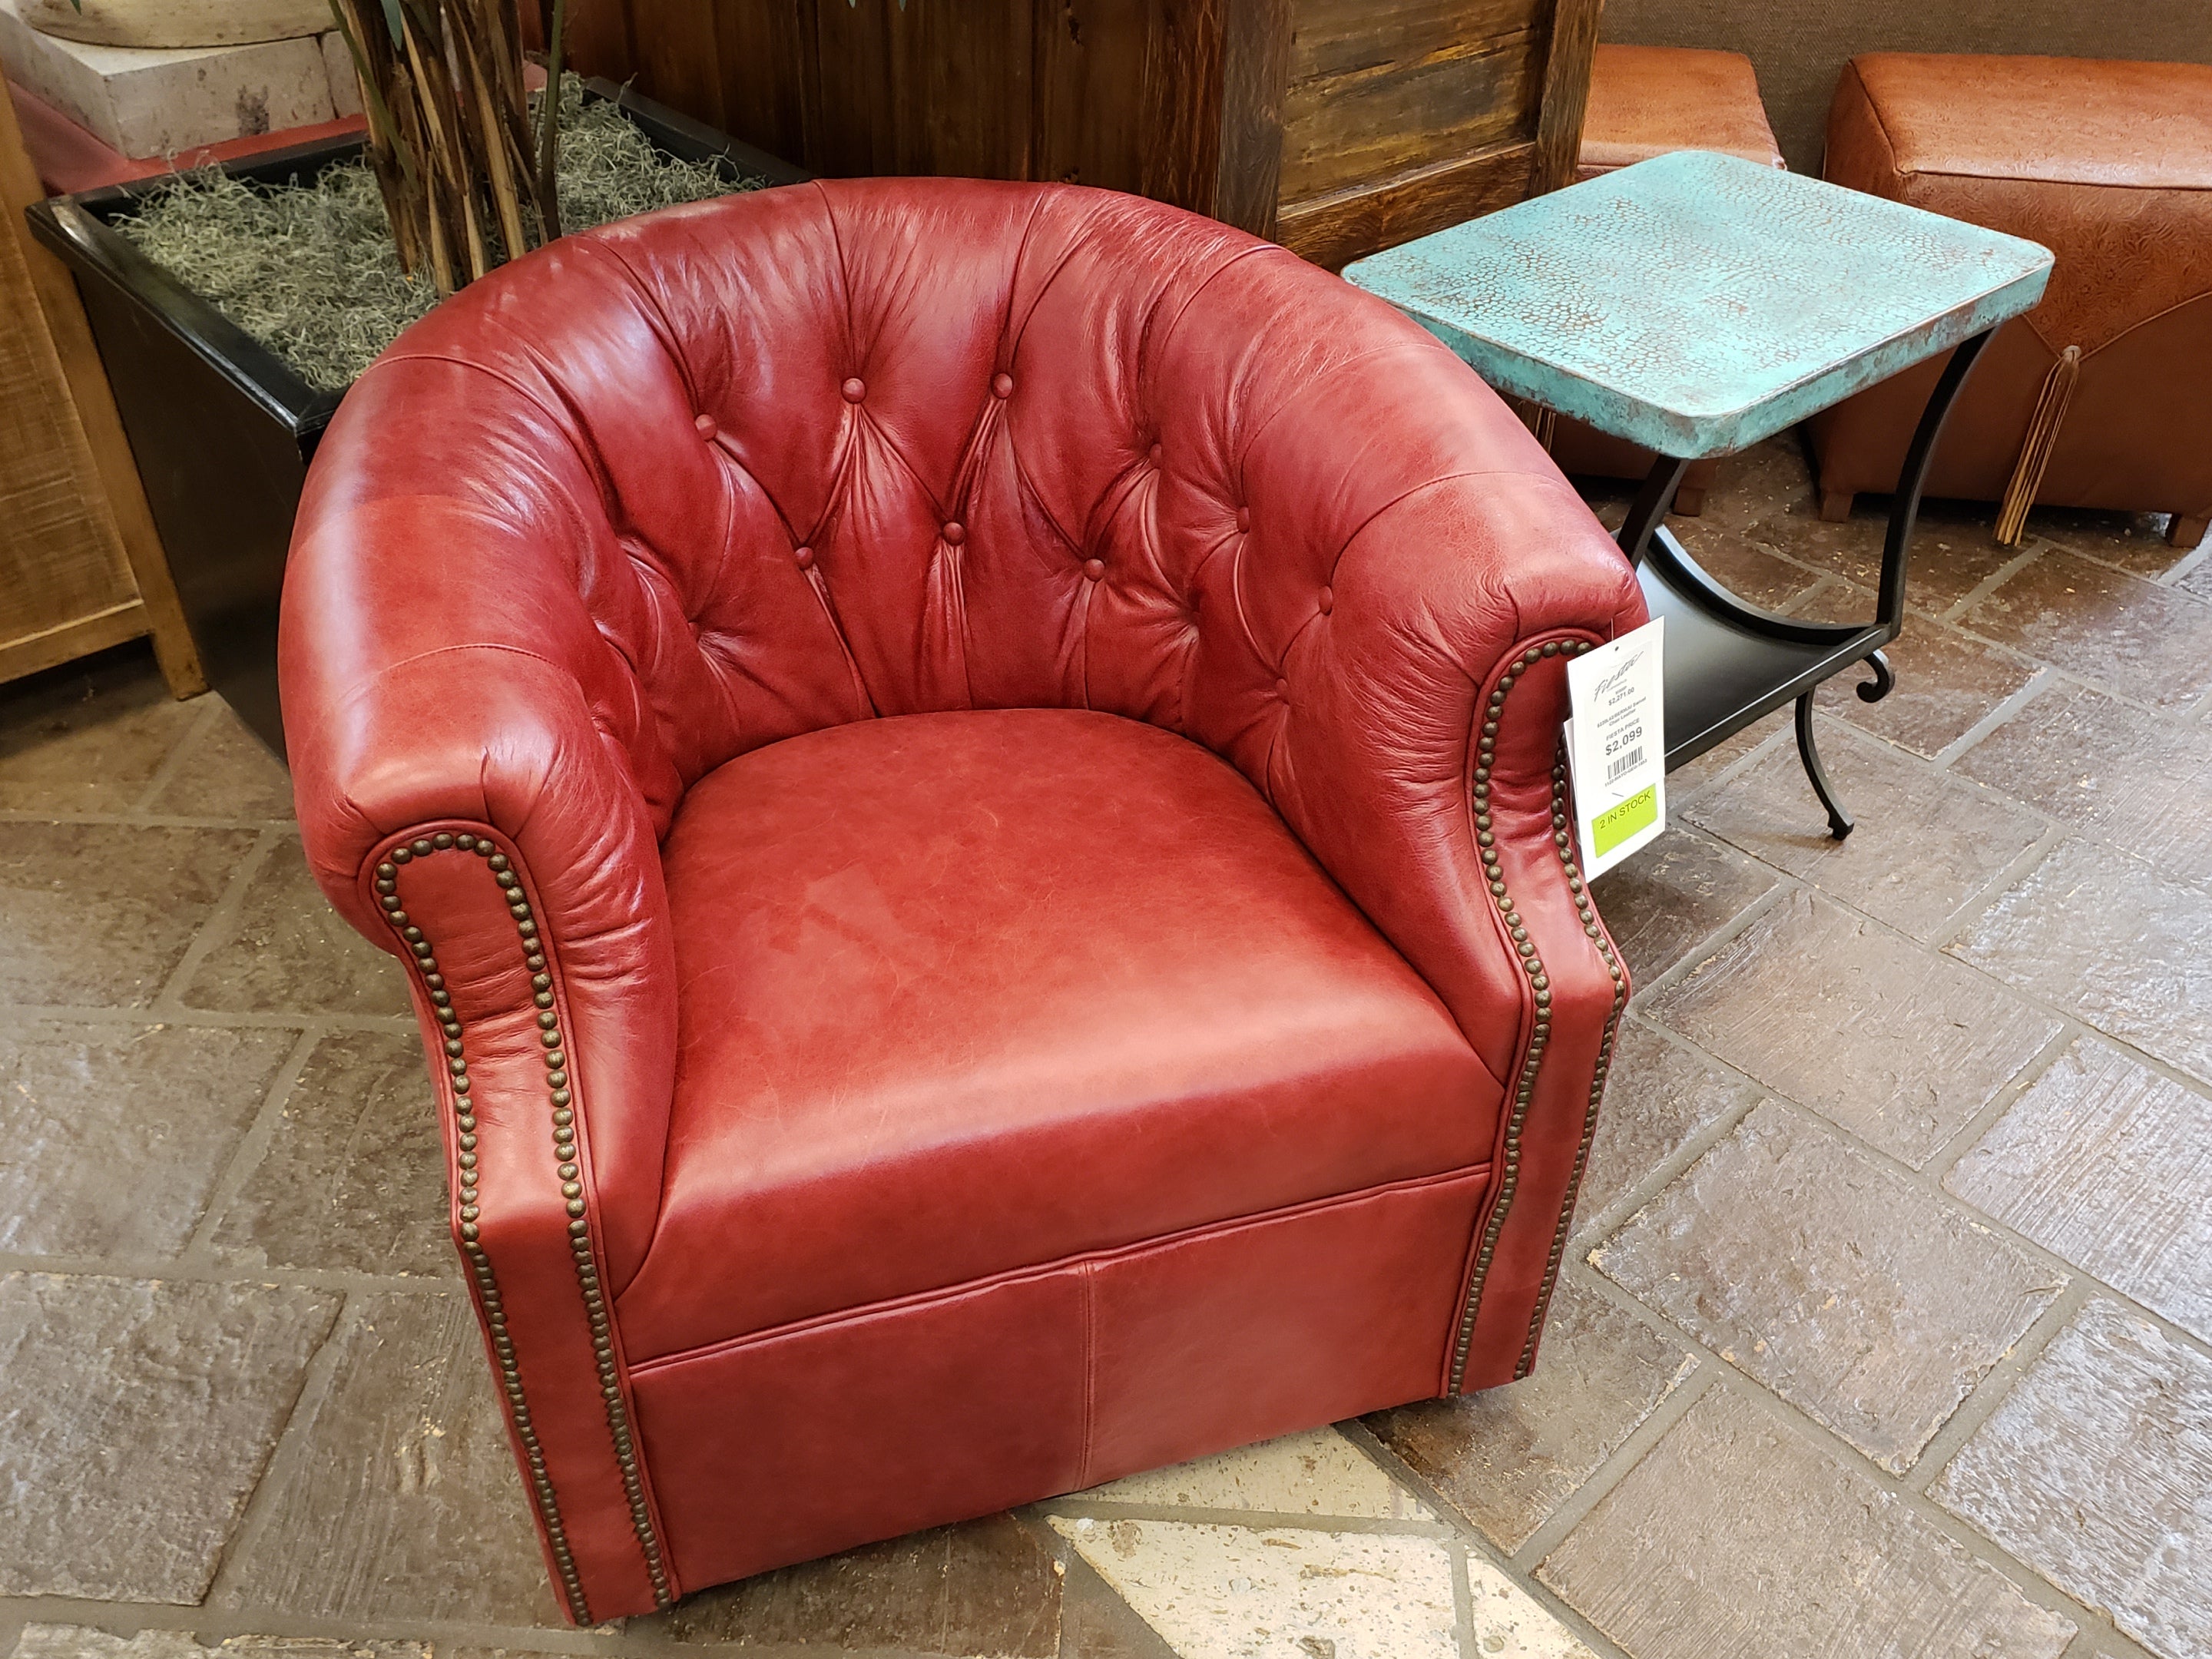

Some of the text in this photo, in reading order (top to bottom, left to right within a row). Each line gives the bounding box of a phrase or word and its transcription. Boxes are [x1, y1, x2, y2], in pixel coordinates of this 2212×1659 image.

[1605, 726, 1642, 756] $2,099
[1606, 717, 1640, 741] FIESTA PRICE
[1600, 790, 1651, 830] 2 IN STOCK
